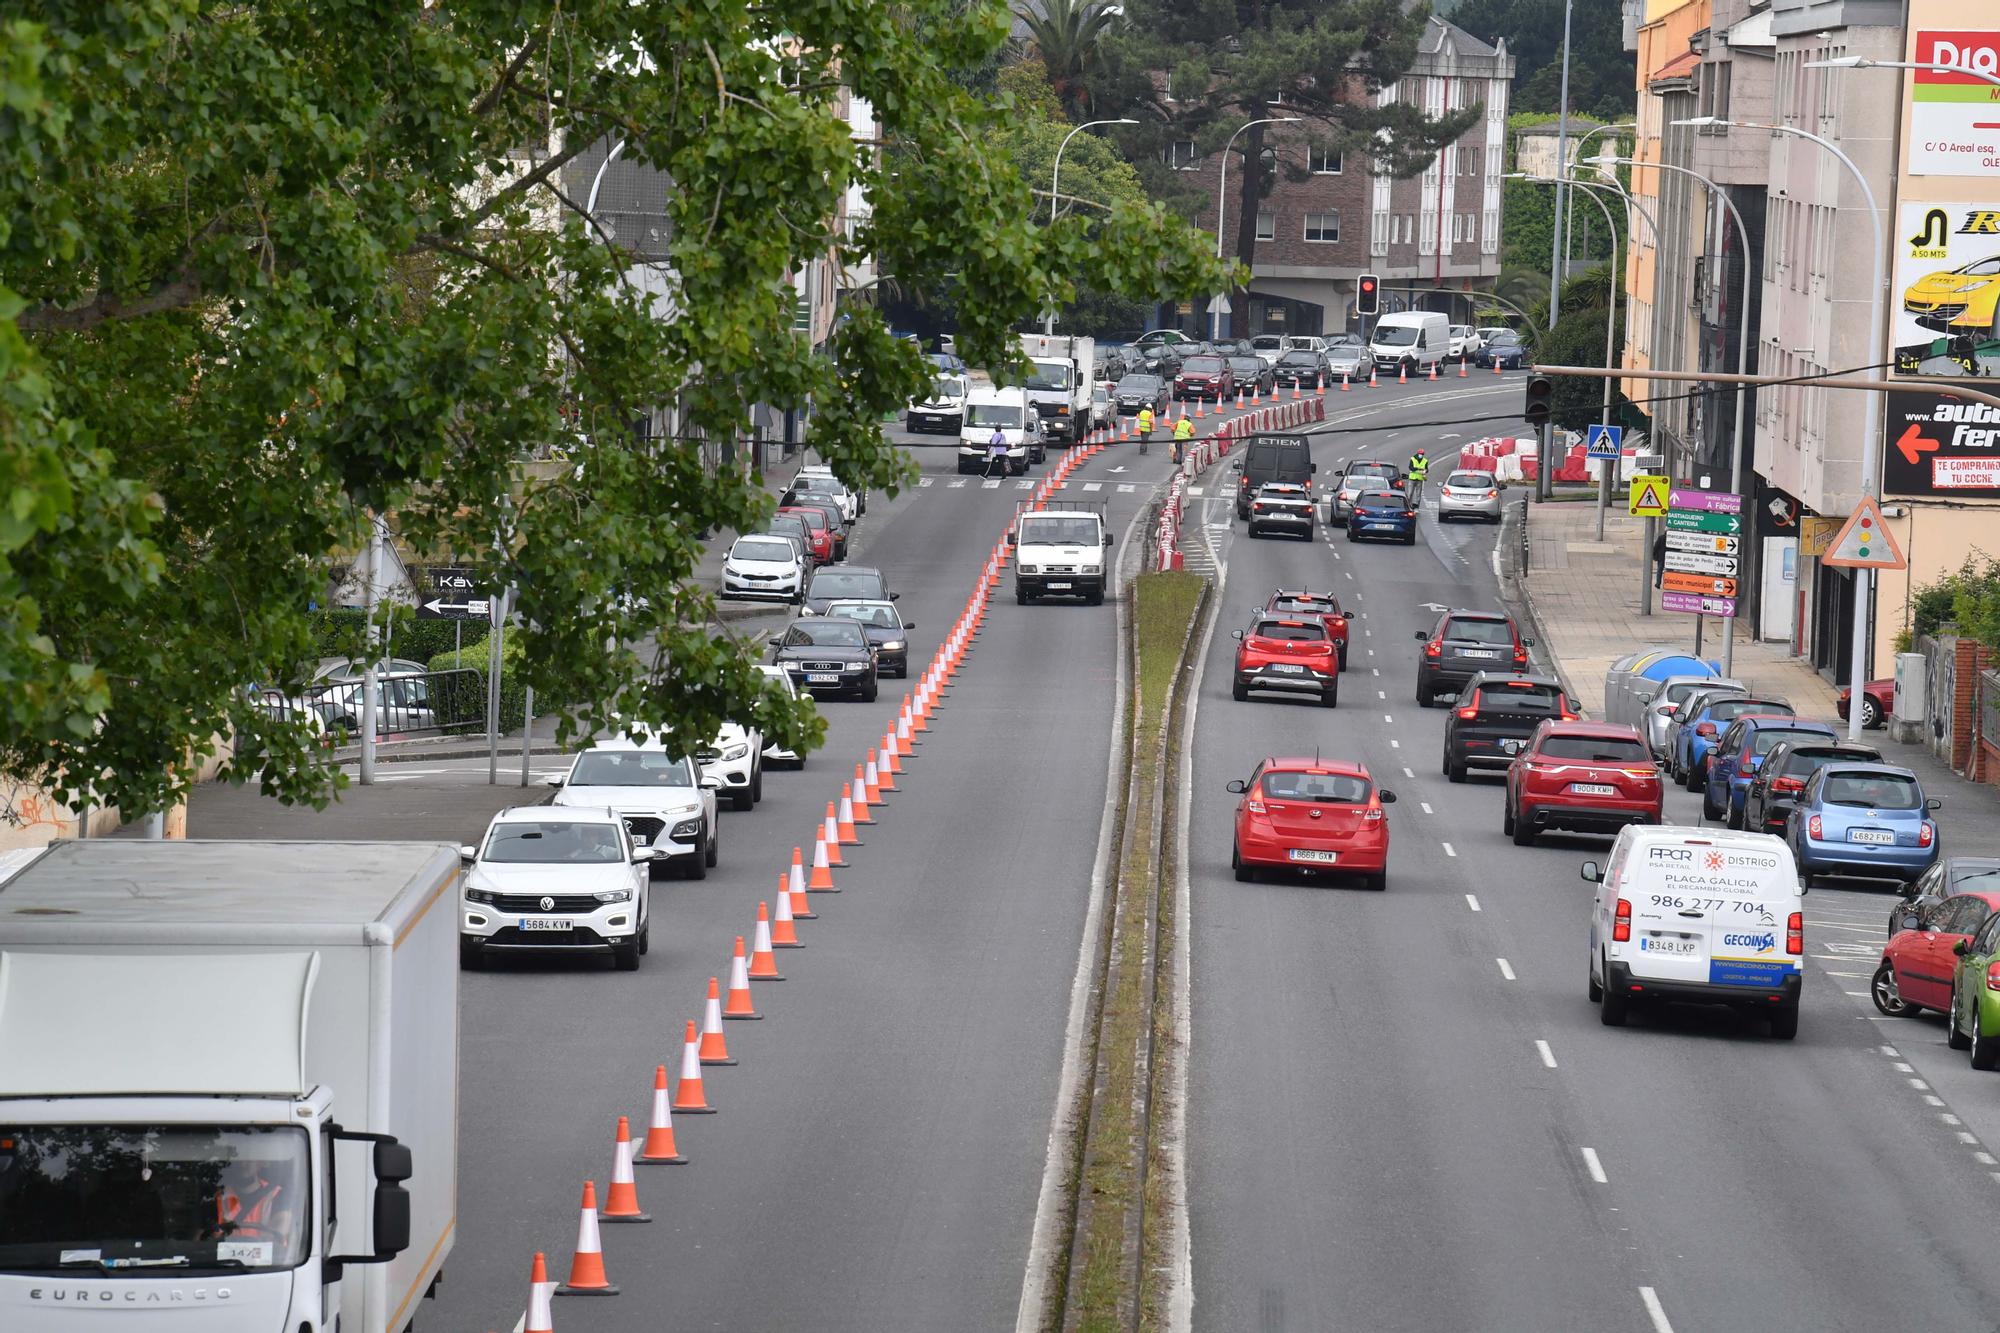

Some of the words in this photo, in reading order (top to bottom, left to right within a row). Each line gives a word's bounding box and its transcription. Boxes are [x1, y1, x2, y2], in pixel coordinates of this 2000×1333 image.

[1939, 143, 1947, 152] O
[1949, 143, 1975, 153] Areal
[1977, 145, 1997, 156] esq.
[1919, 250, 1929, 258] 50
[1930, 250, 1946, 258] MTS
[1938, 461, 1948, 471] TE
[1952, 474, 1962, 483] TU
[1965, 474, 1993, 483] COCHE
[1685, 580, 1712, 589] municipal
[1577, 783, 1596, 792] 9008
[1853, 832, 1874, 841] 4682
[1876, 833, 1892, 842] FVH
[1296, 850, 1315, 859] 8669
[1728, 856, 1776, 867] DISTRIGO
[1665, 874, 1706, 884] PLACA
[1709, 877, 1758, 888] GALICIA
[1678, 884, 1721, 892] RECAMBIO
[1651, 894, 1684, 908] 986
[1691, 898, 1724, 911] 277
[1732, 901, 1765, 914] 704
[526, 920, 550, 930] 5684
[553, 920, 571, 930] KVW
[1648, 940, 1674, 951] 8348
[1676, 942, 1695, 953] LKP
[1724, 932, 1775, 951] GECOINSA
[29, 1287, 233, 1302] EUROCARGO
